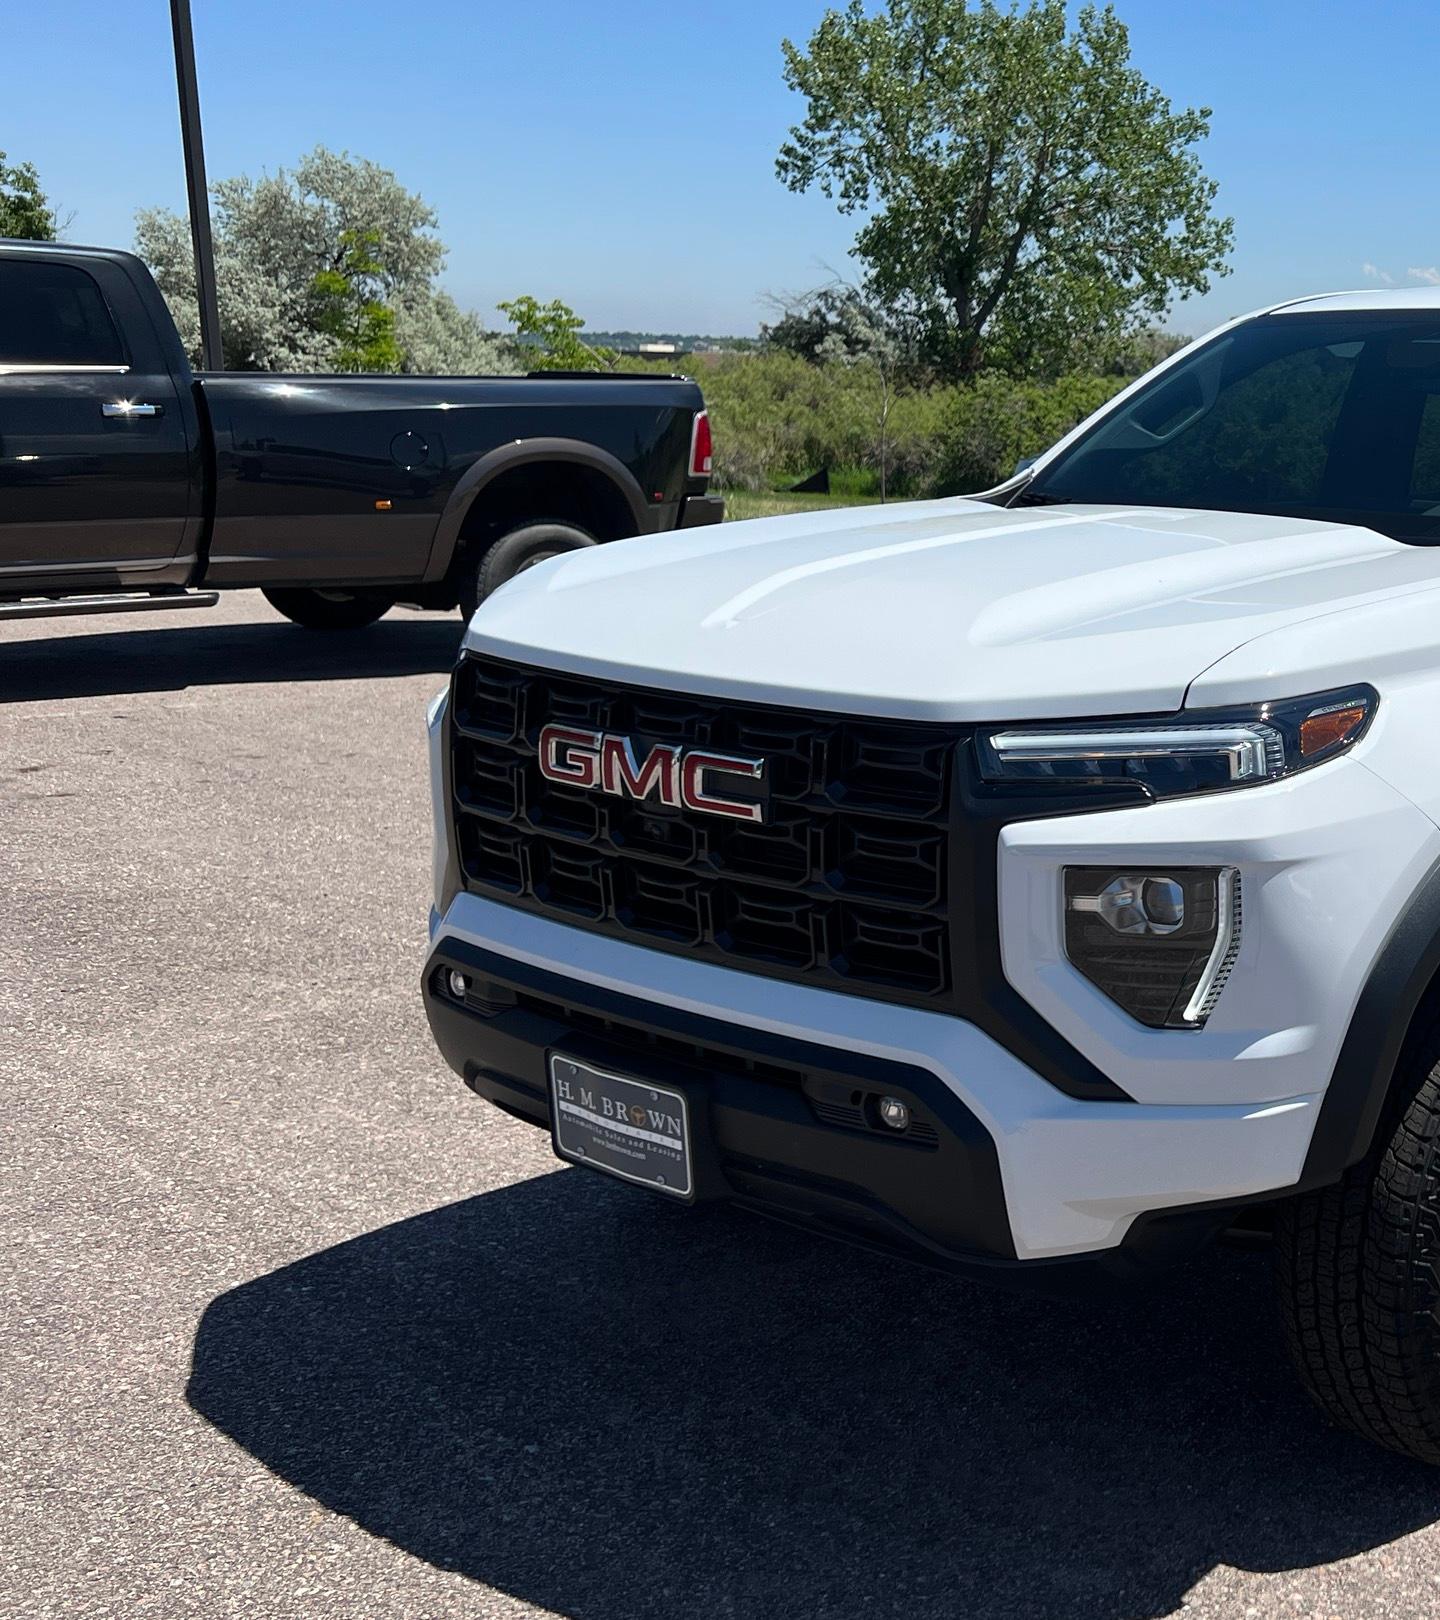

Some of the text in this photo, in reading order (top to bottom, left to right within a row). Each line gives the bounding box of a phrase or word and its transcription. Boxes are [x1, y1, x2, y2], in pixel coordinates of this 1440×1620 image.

[539, 723, 764, 823] GMC
[556, 1079, 682, 1137] H. M. BROWN
[605, 1129, 627, 1144] Sales
[628, 1136, 644, 1149] and
[646, 1141, 682, 1161] Leasing
